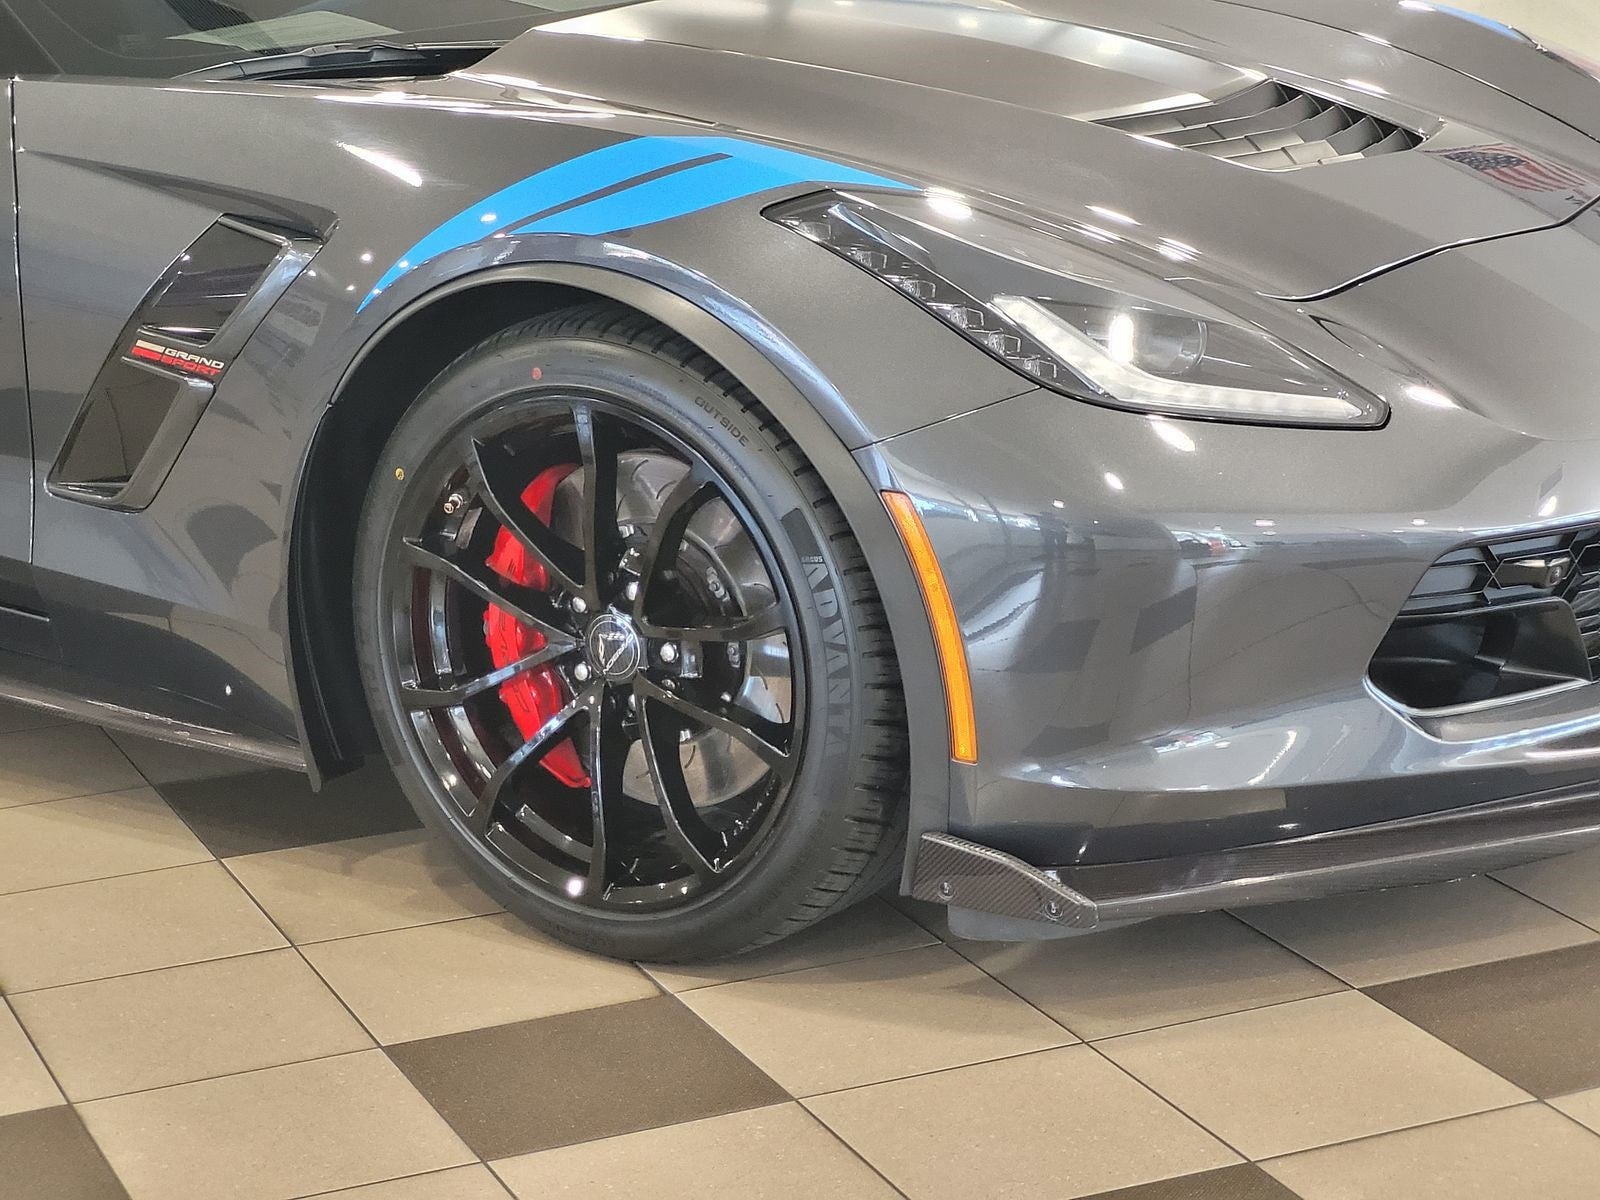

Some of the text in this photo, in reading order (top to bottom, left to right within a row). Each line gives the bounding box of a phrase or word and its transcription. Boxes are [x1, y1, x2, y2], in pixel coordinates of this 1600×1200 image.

[161, 355, 221, 376] SPORT
[165, 347, 224, 369] GRAND
[694, 396, 749, 447] OUTSIDE
